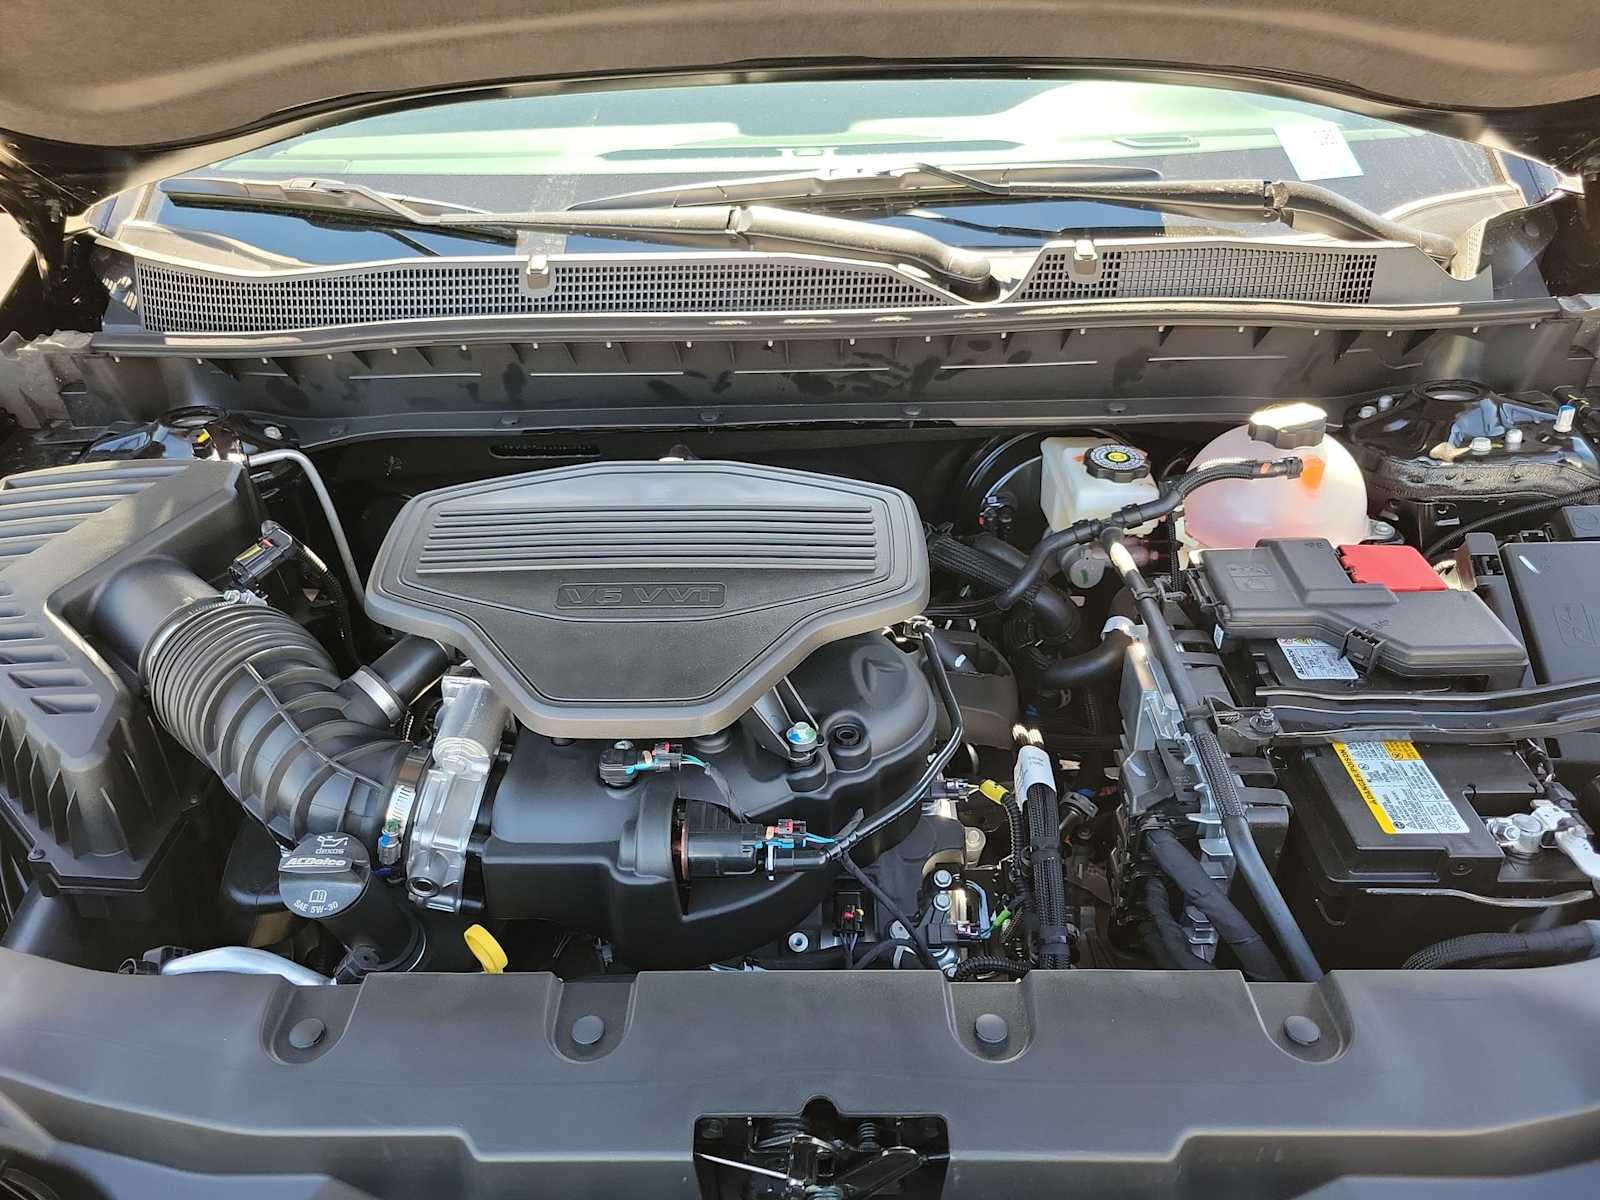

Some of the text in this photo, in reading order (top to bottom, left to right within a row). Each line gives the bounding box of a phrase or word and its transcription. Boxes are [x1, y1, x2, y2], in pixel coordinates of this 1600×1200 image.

[564, 587, 720, 603] V6 VVT
[315, 847, 345, 855] dexos
[285, 857, 347, 867] ACDelco
[294, 900, 339, 914] SAE 5W-30
